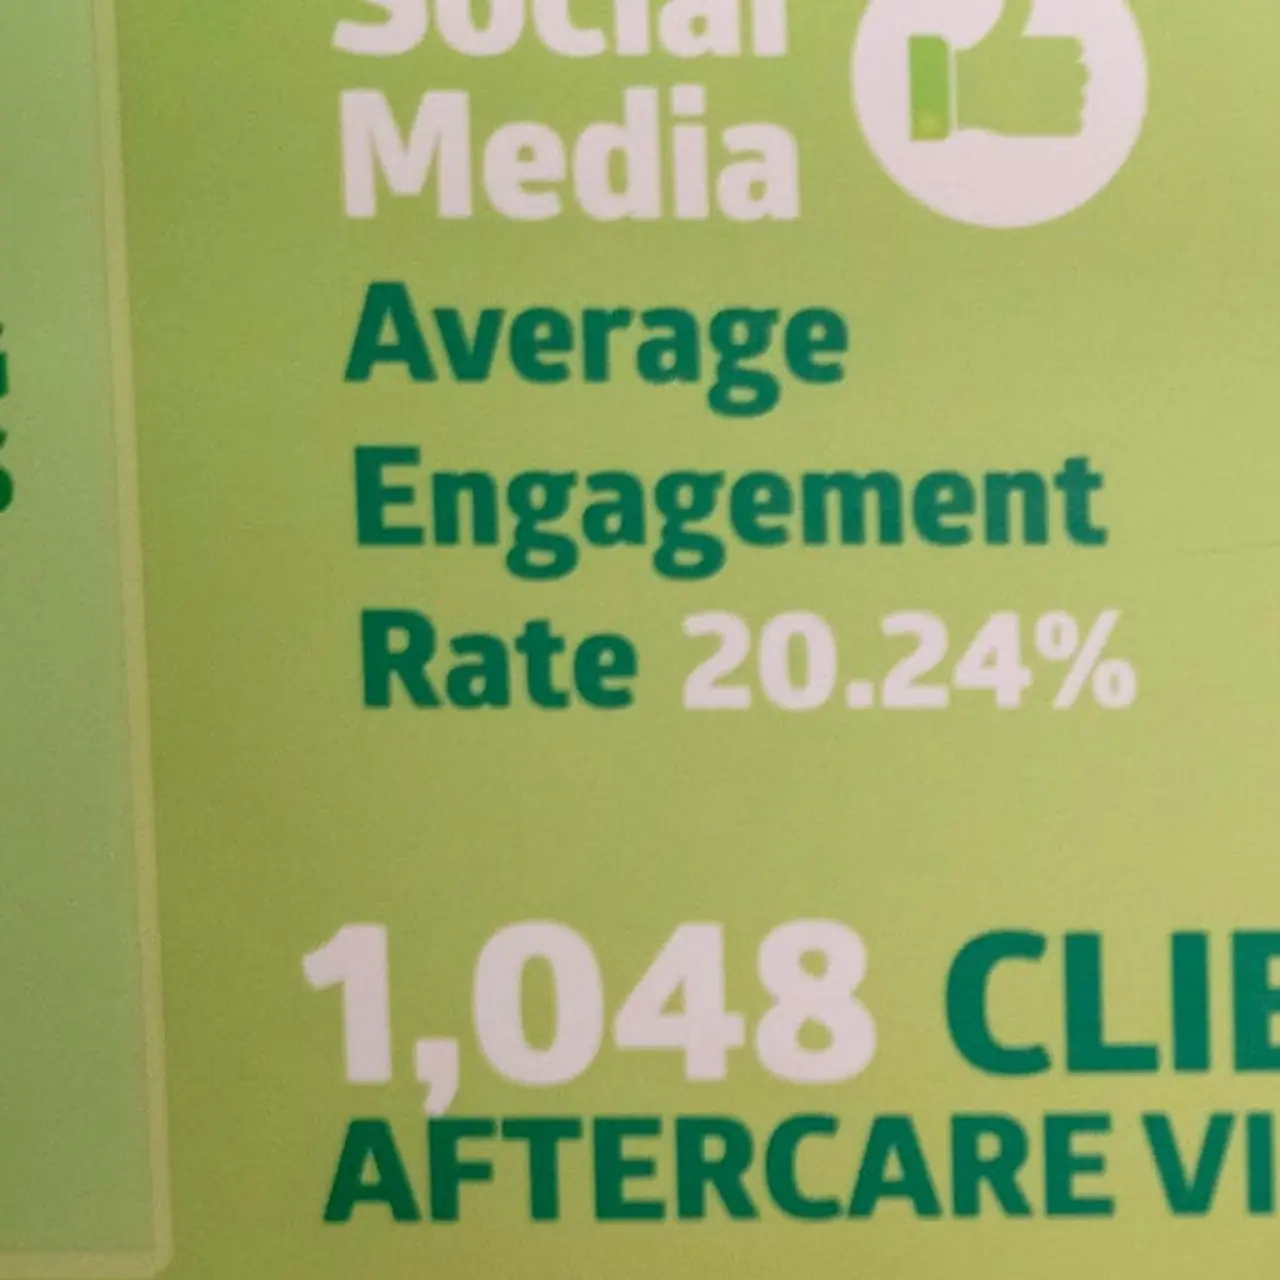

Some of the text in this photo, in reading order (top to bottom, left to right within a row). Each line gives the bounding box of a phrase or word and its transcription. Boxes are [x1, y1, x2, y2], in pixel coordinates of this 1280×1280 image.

[341, 84, 800, 220] Media
[343, 280, 849, 418] Average
[353, 444, 1108, 582] Engagement
[360, 608, 1138, 711] Rate 20.24%
[302, 917, 878, 1115] 1,048
[321, 1112, 1115, 1225] AFTERCARE
